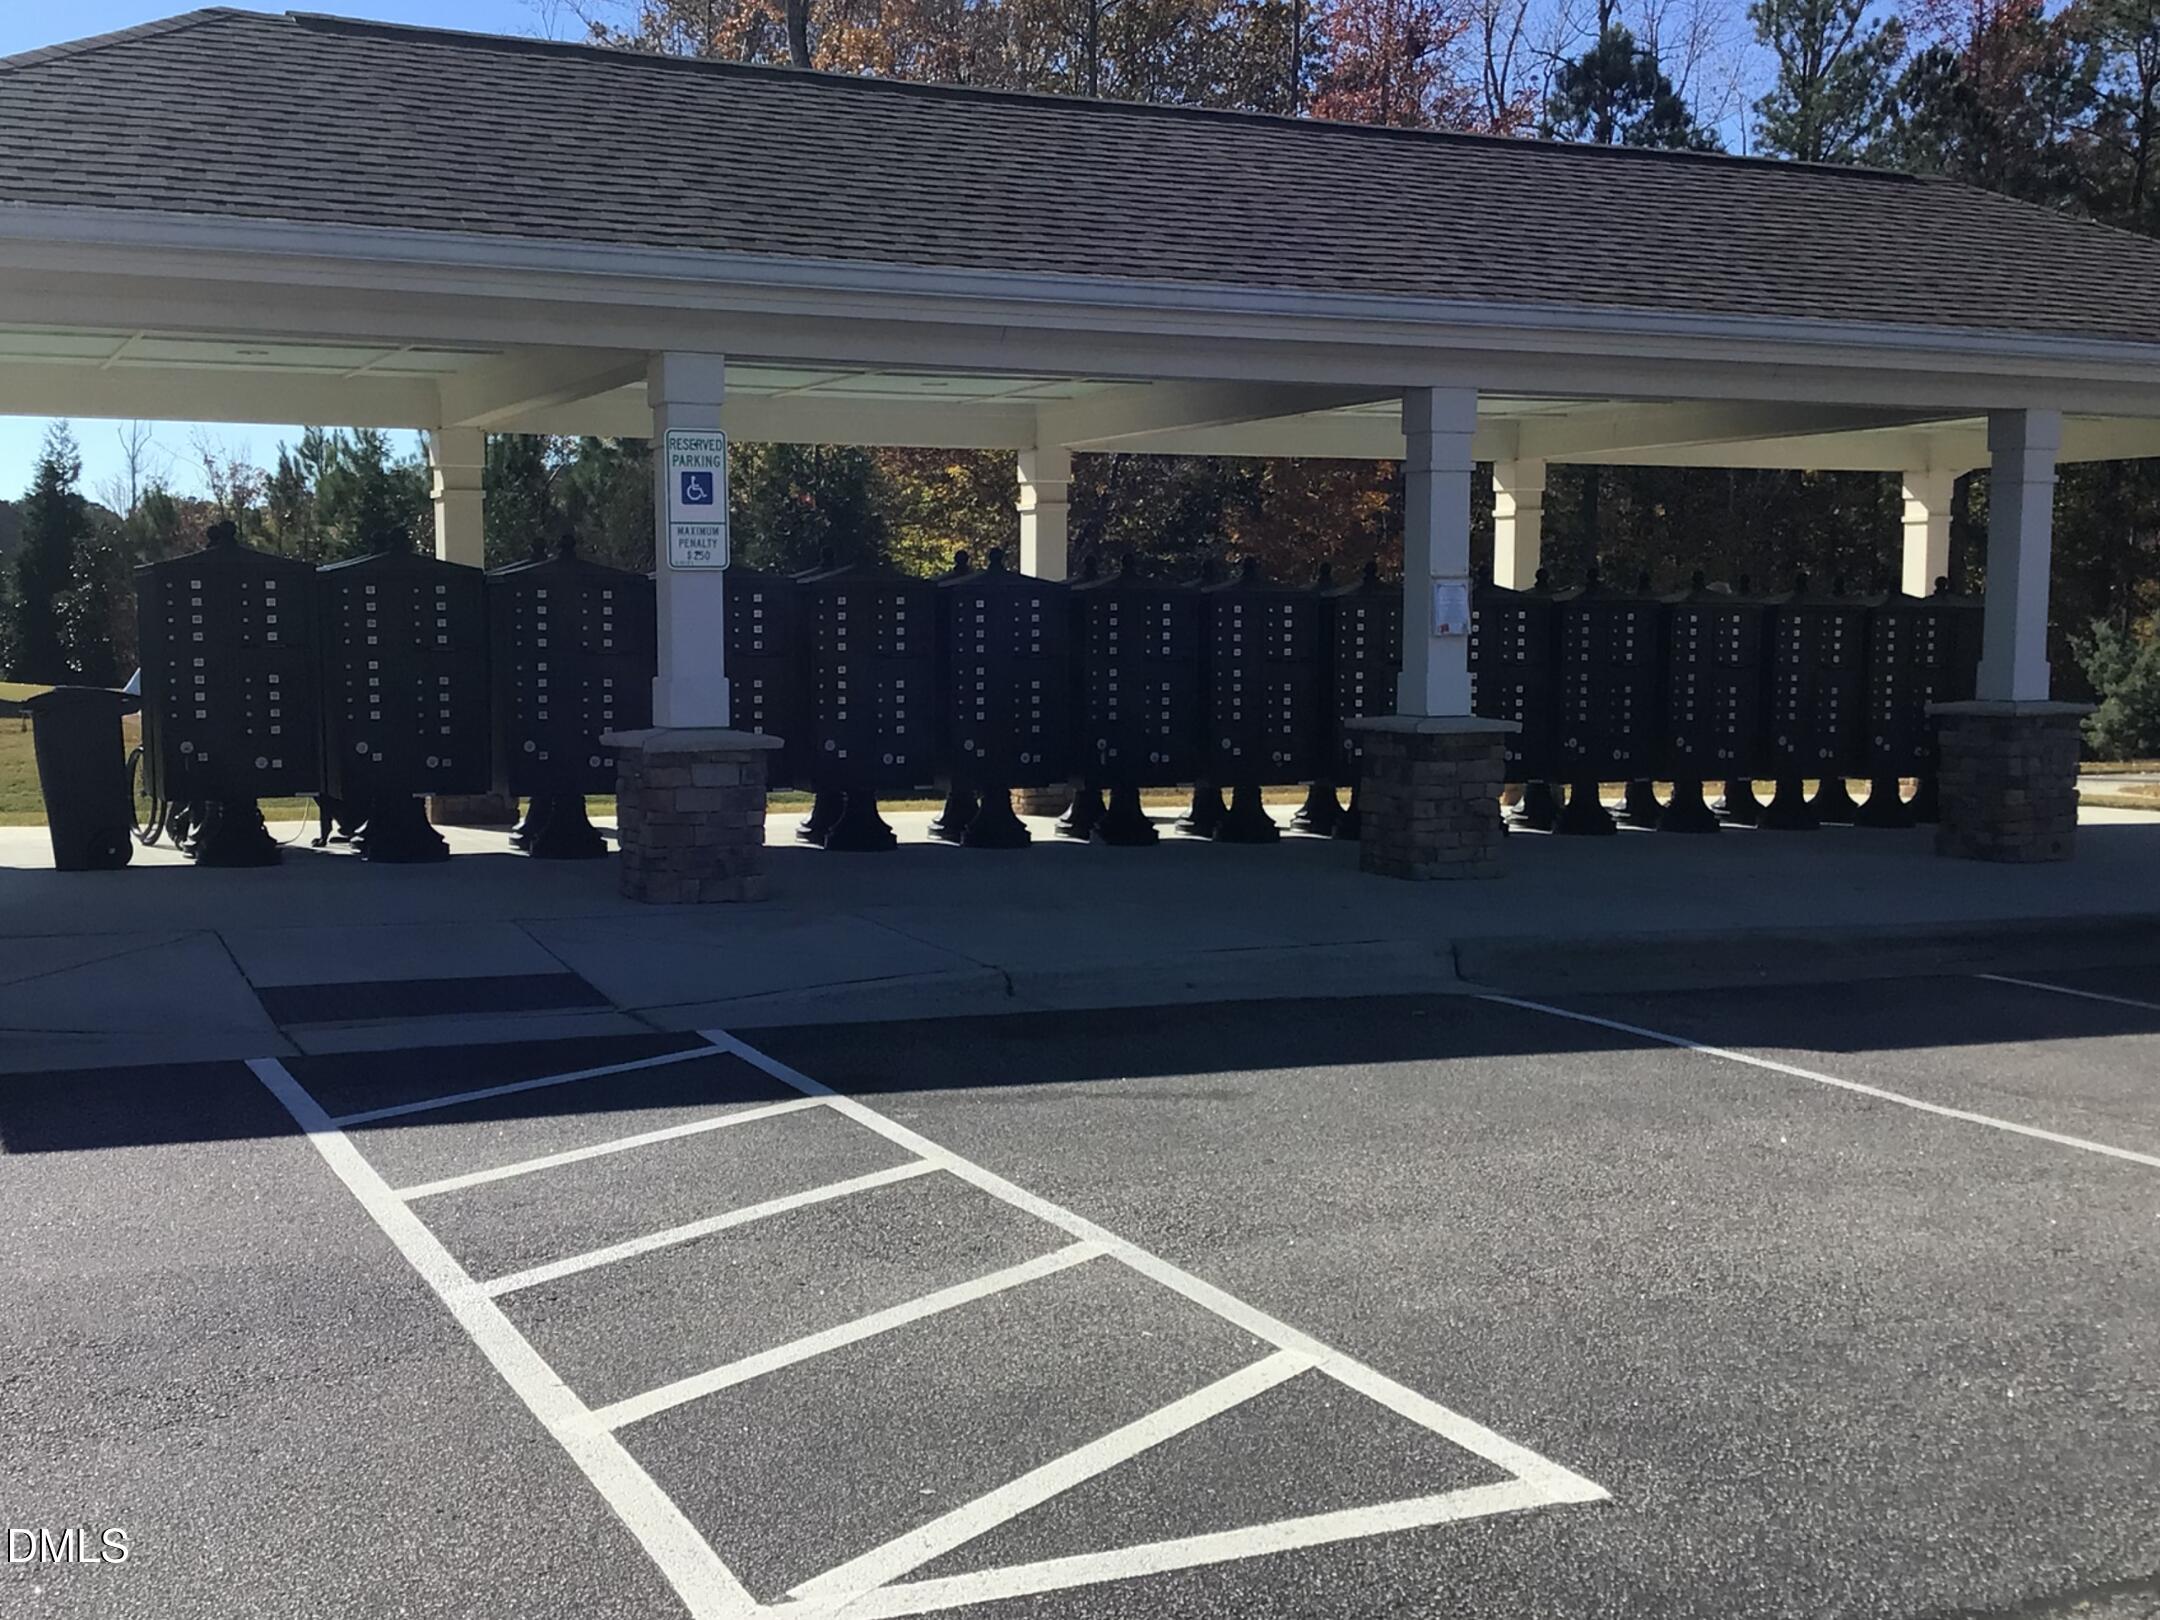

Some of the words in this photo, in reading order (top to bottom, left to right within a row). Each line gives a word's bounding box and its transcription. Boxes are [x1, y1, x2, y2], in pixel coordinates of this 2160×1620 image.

[669, 438, 723, 452] RESERVED
[672, 455, 721, 468] PARKING
[677, 527, 720, 536] MAXIMUM
[678, 538, 718, 549] PENALTY
